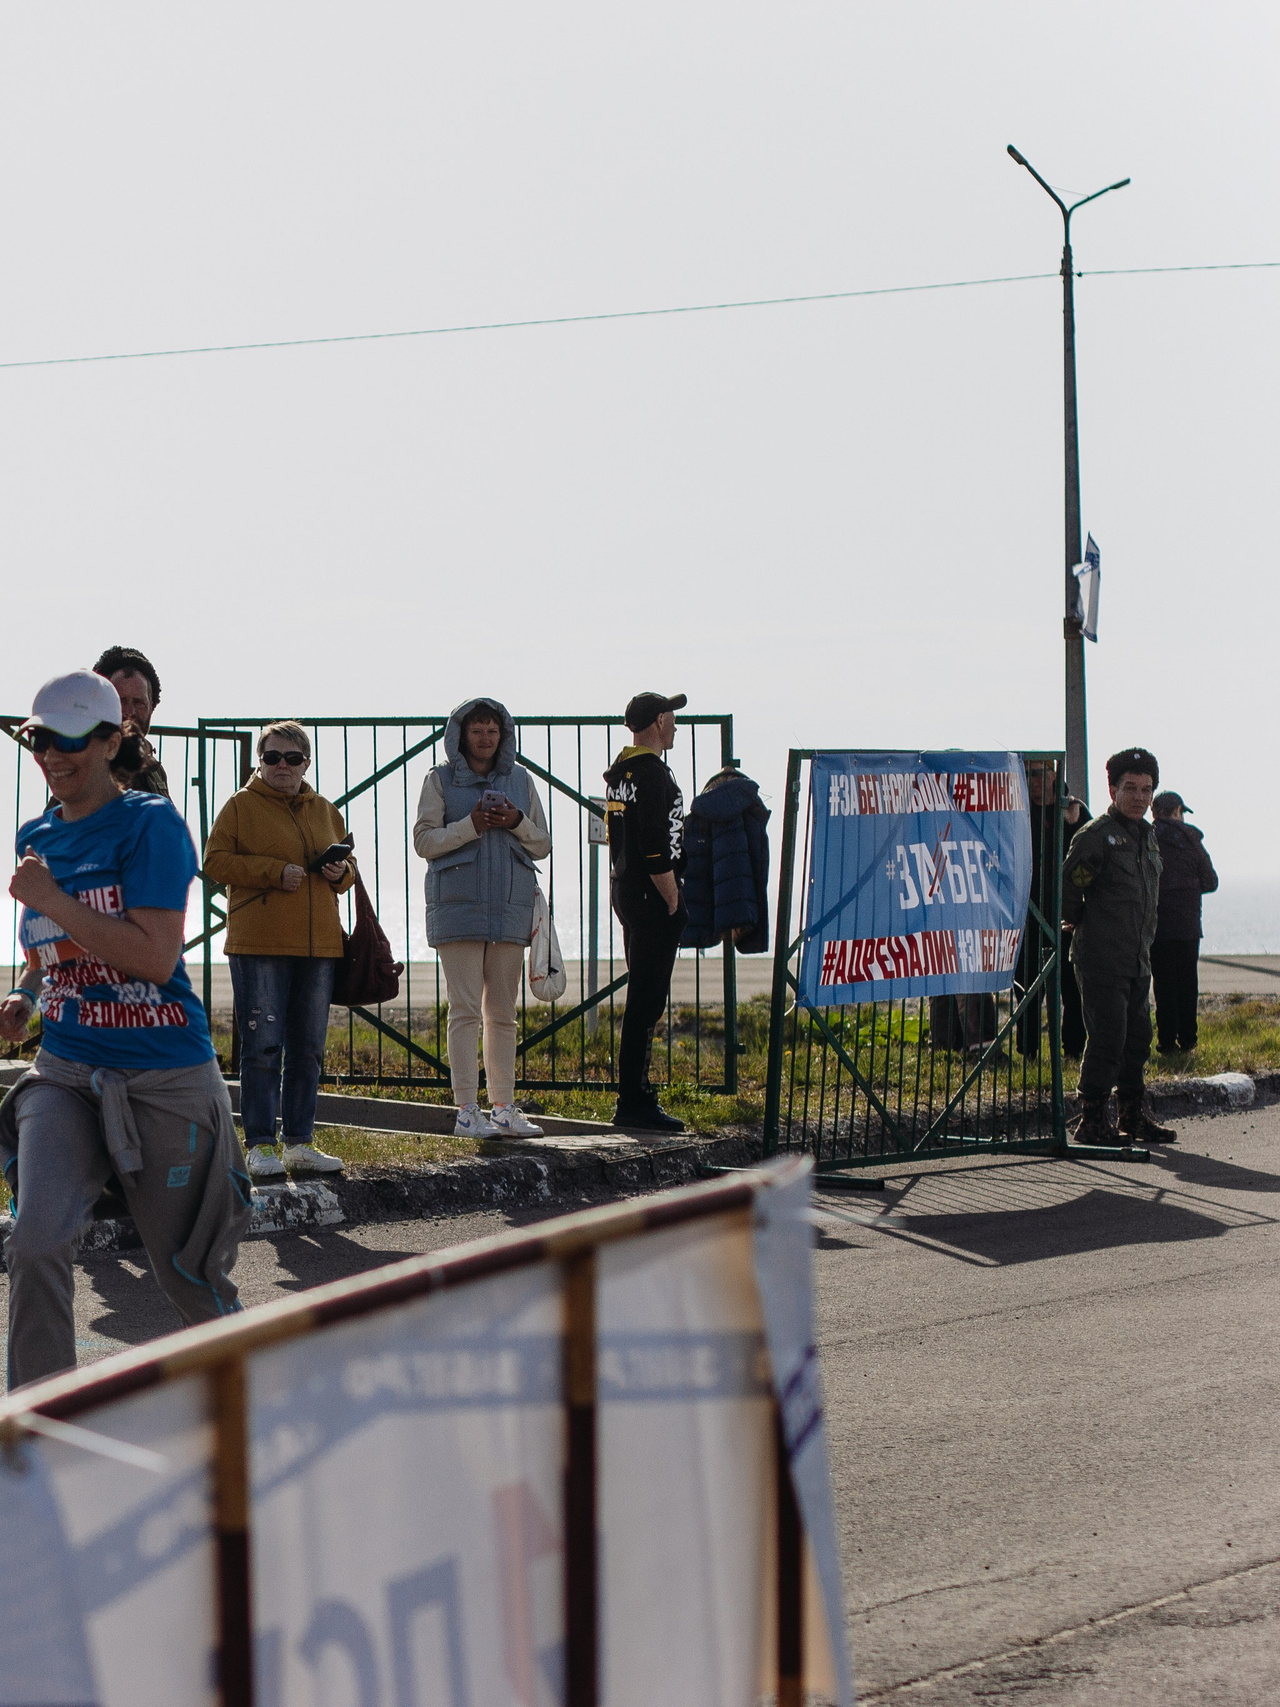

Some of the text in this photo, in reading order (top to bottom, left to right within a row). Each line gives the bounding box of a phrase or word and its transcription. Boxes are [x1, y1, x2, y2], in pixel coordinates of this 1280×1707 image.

[829, 774, 883, 816] #ЗАБЕГ
[881, 773, 954, 814] #СВОБОДА
[820, 930, 959, 986] #АДРЕНАЛИН
[958, 929, 998, 973] #ЗАБЕГ
[112, 983, 161, 1005] 2024
